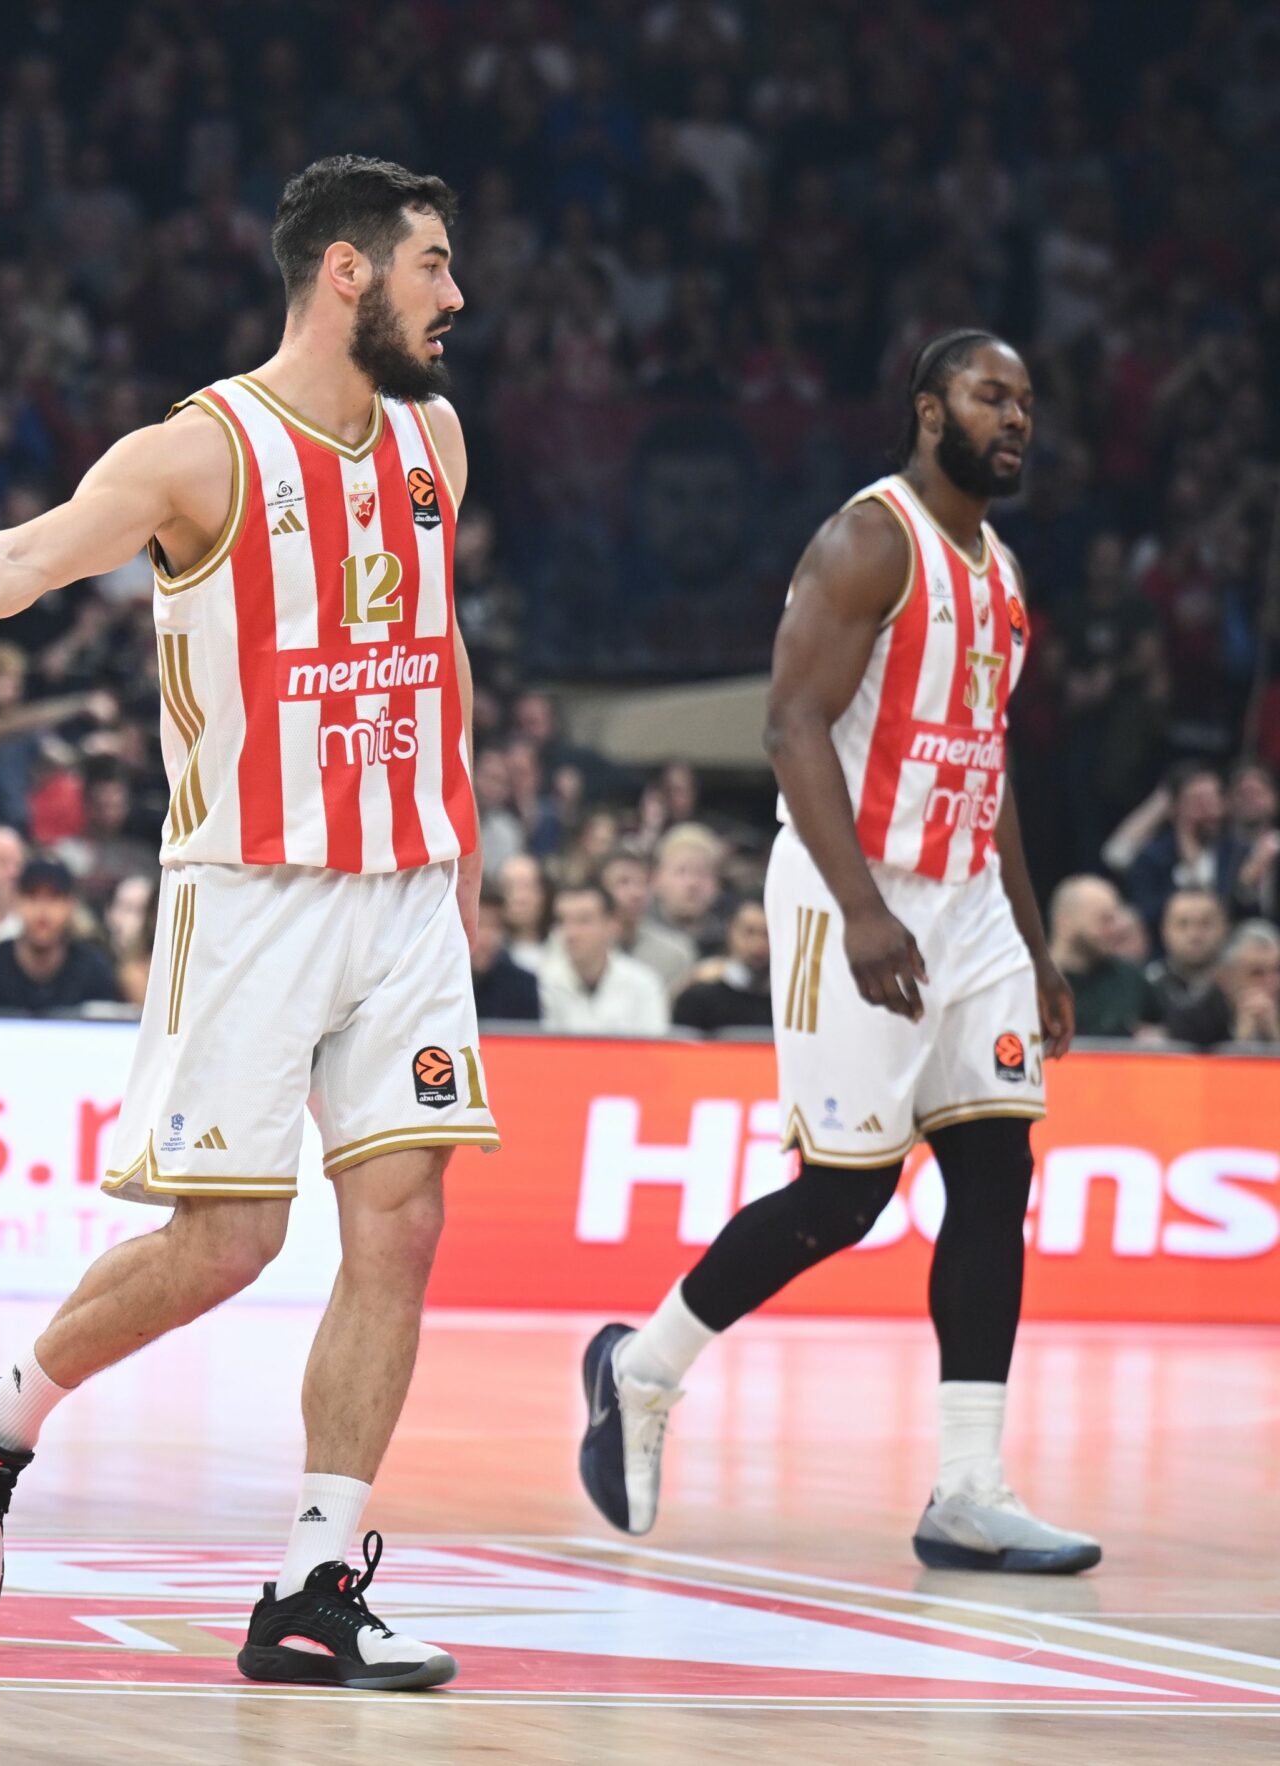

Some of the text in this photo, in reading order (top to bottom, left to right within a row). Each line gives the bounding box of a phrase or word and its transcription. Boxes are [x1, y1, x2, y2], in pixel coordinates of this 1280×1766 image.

[340, 551, 403, 627] 12
[287, 645, 439, 696] meridian
[320, 707, 418, 768] mts
[458, 1046, 488, 1108] 1
